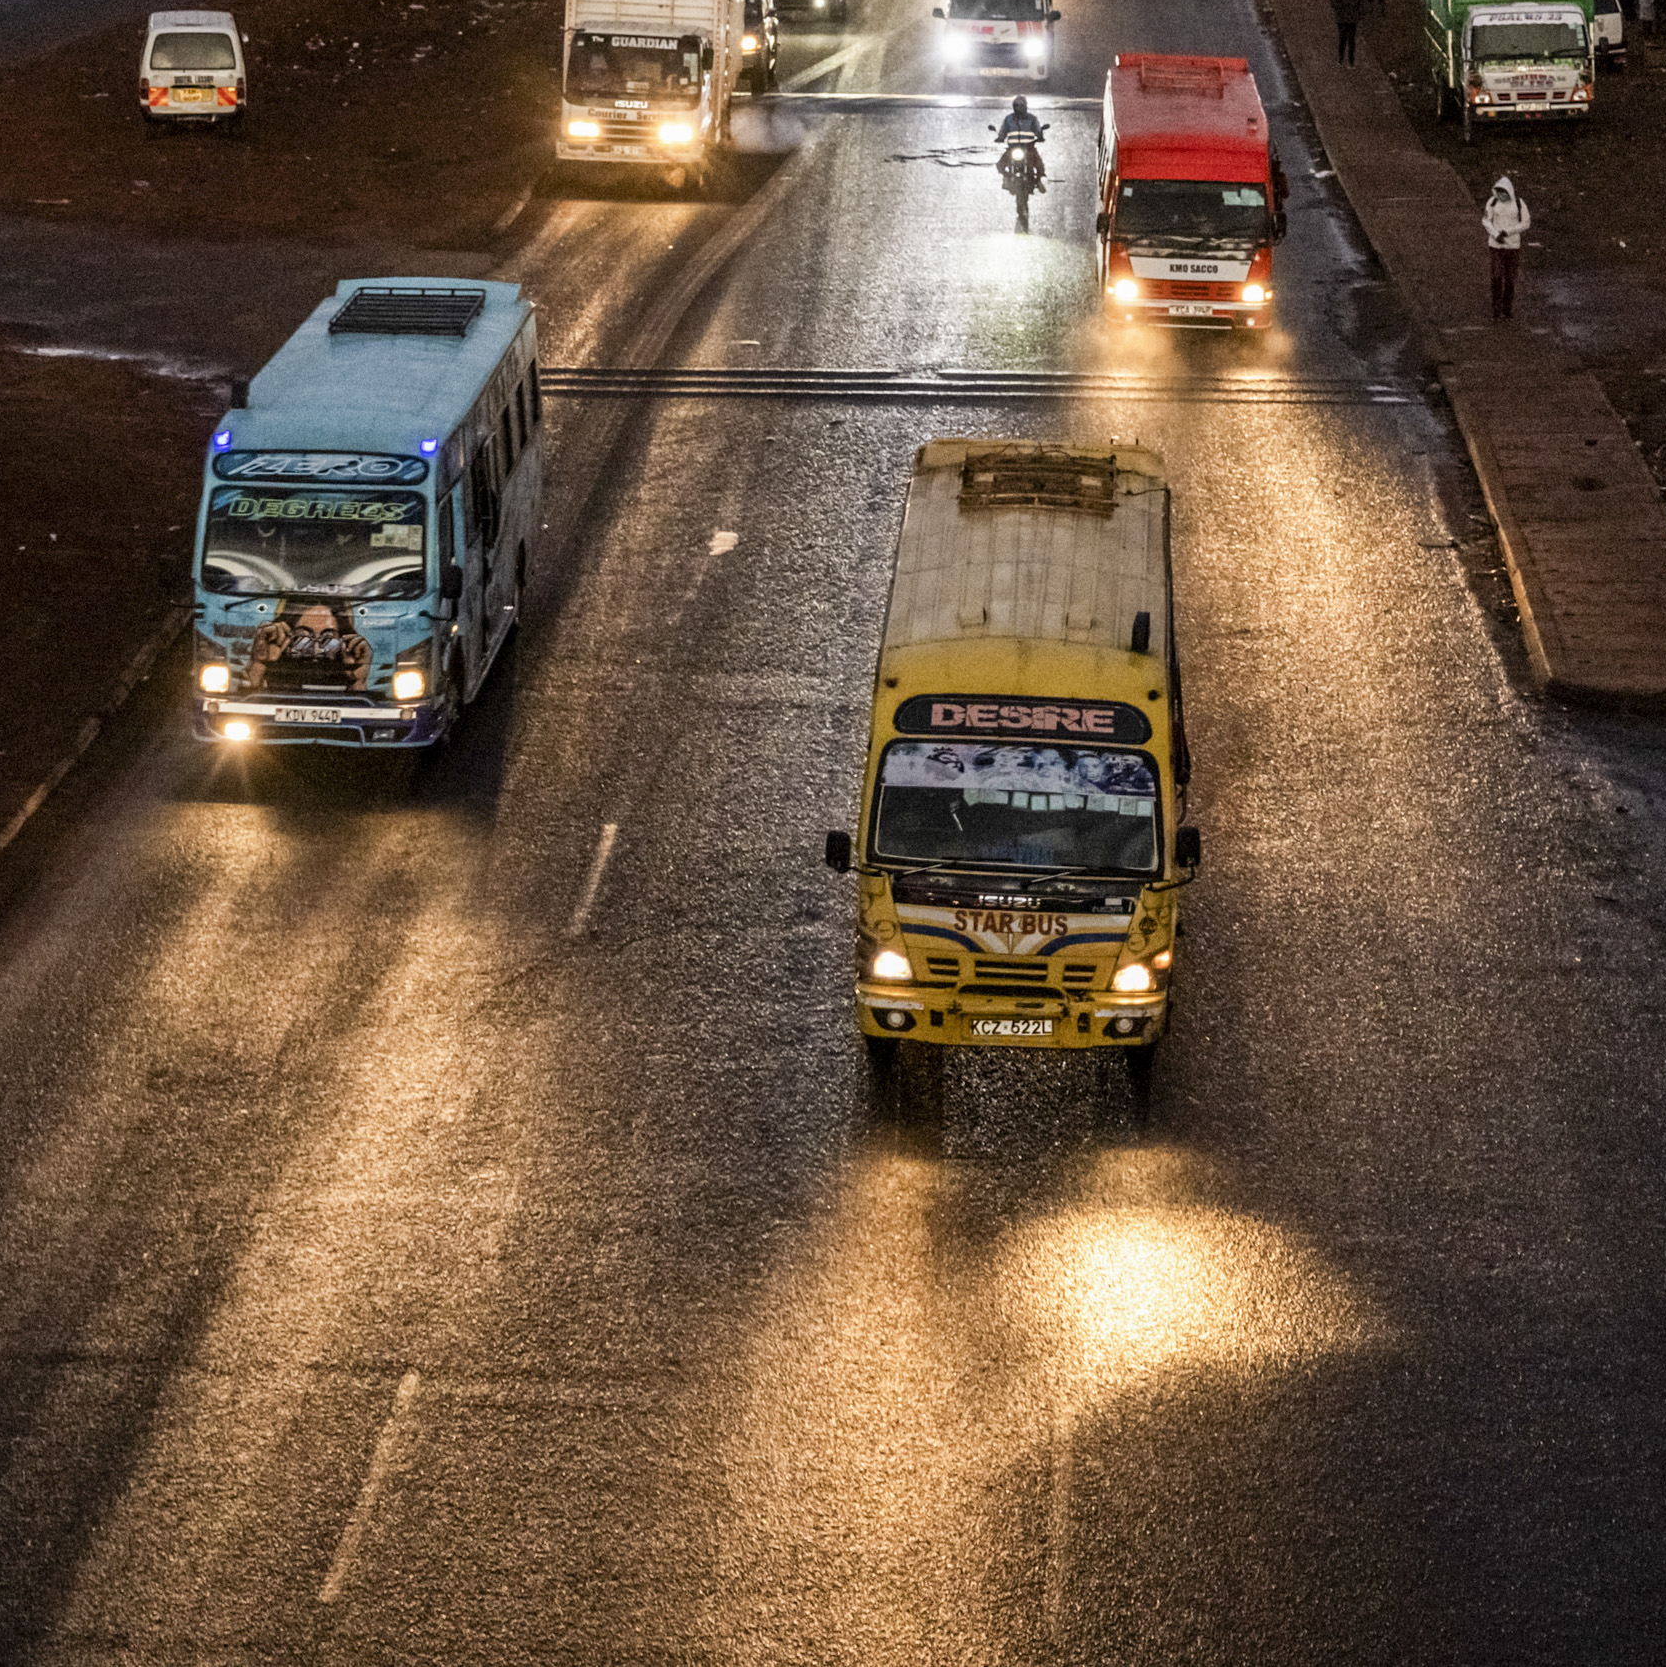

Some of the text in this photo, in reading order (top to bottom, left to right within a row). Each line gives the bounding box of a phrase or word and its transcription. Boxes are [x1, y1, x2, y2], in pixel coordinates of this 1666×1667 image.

[592, 35, 678, 50] The GUARDIAN
[614, 100, 648, 109] ISUZU
[588, 108, 627, 120] Courier
[1169, 264, 1218, 274] KMO SACCO
[229, 454, 405, 477] ZERO
[228, 497, 407, 522] DEGREES
[285, 709, 307, 721] KDV
[931, 703, 1115, 734] DESIRE
[978, 894, 1041, 909] ISUZU
[954, 909, 1069, 937] STAR BUS
[971, 1019, 1001, 1035] KCZ
